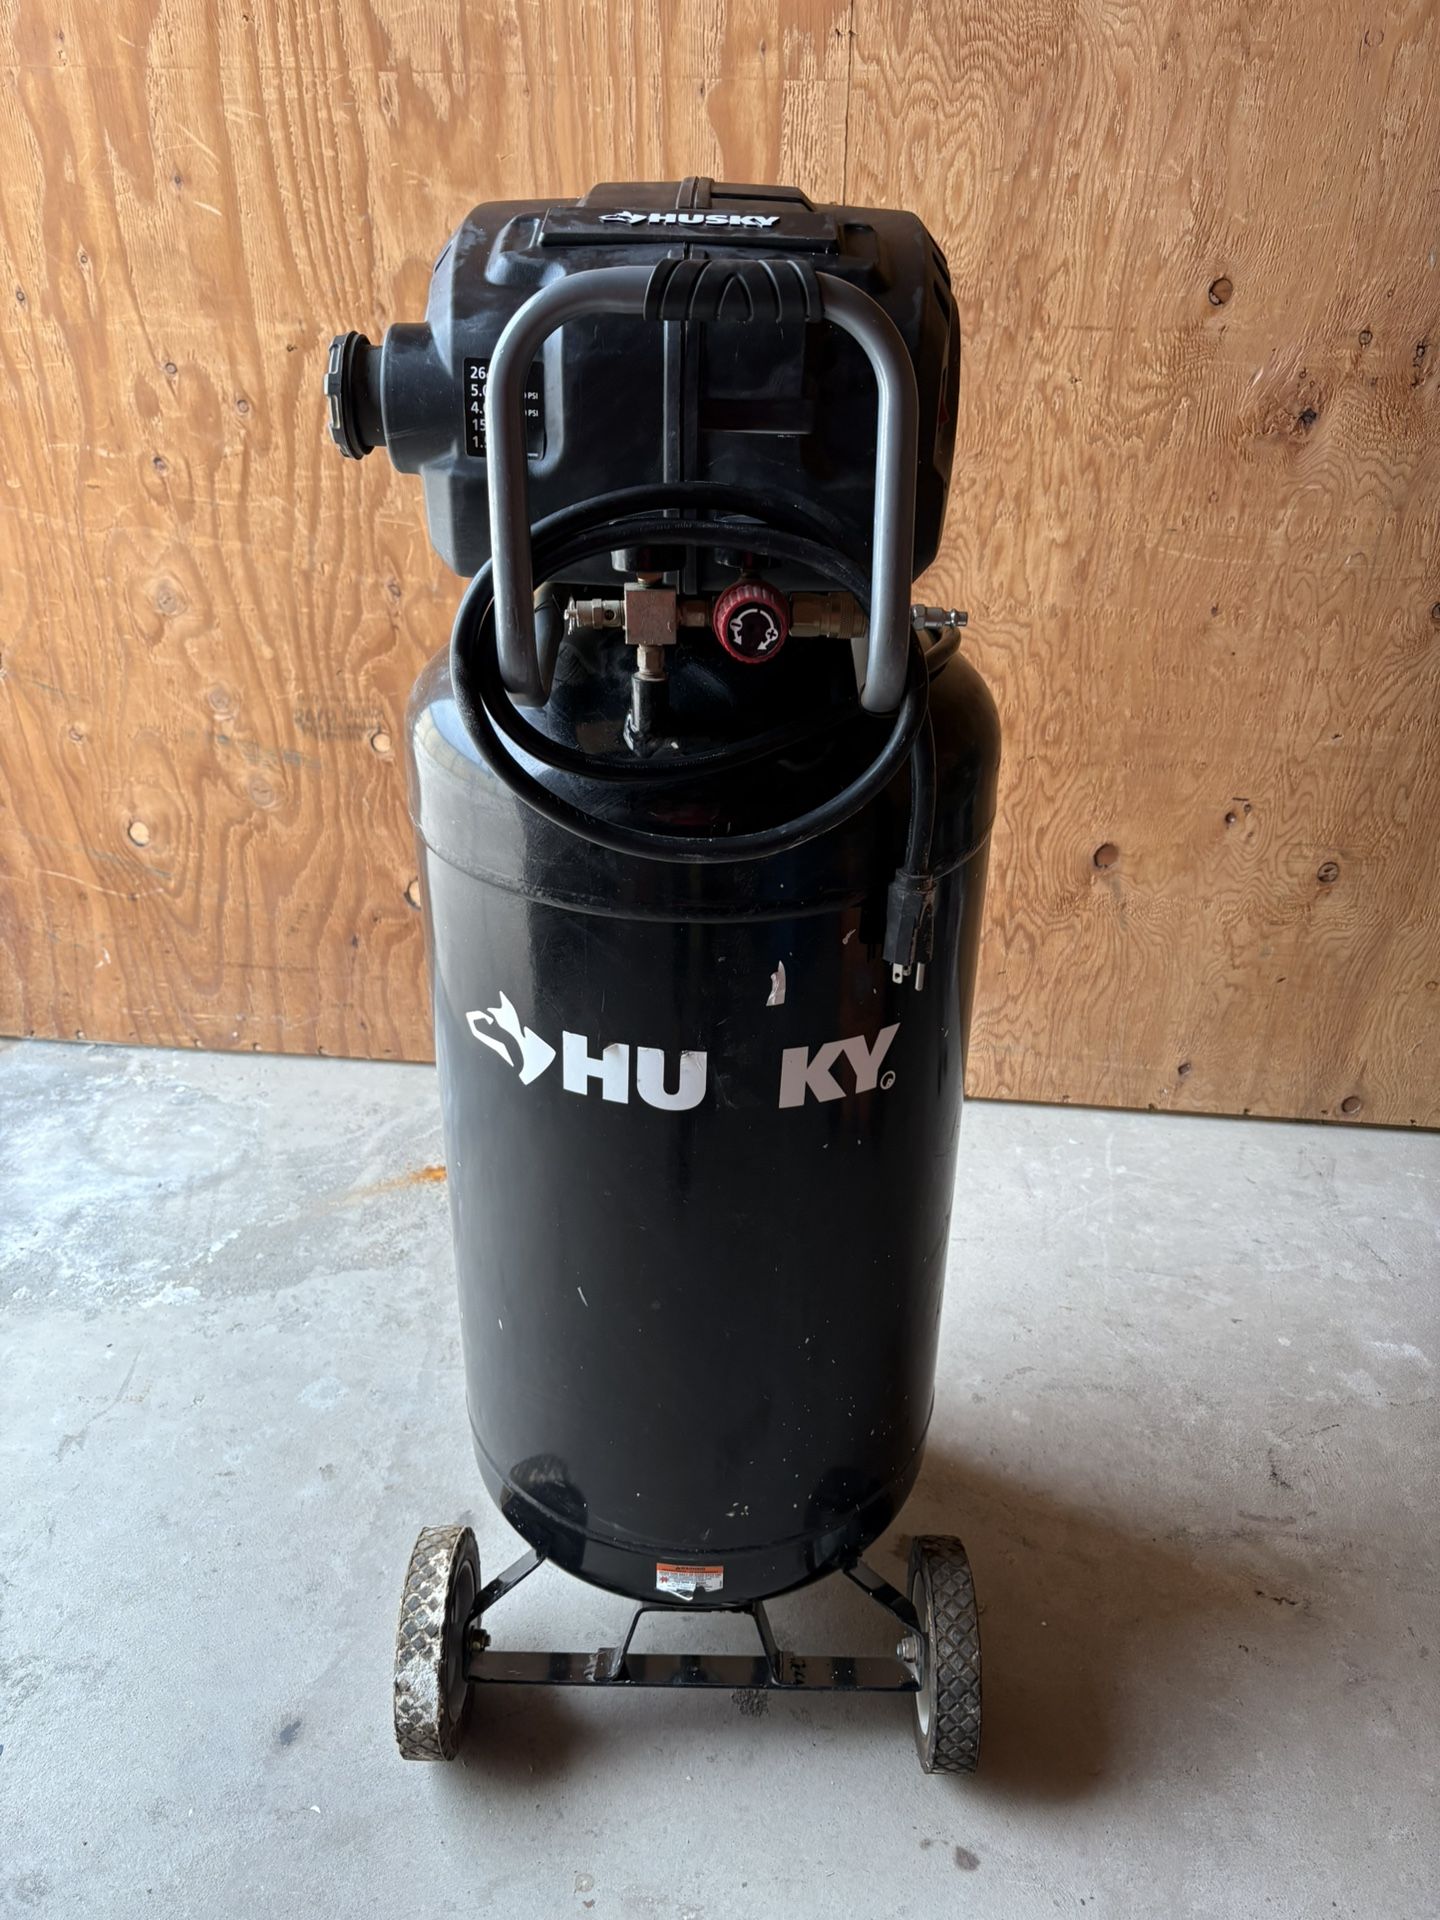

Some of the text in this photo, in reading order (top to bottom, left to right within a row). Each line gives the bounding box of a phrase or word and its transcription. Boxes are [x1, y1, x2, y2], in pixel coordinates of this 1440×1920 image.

[649, 213, 780, 226] HUSKY
[527, 391, 538, 400] PSI
[470, 401, 487, 414] 4.
[528, 408, 539, 417] PSI
[472, 435, 487, 449] 1.
